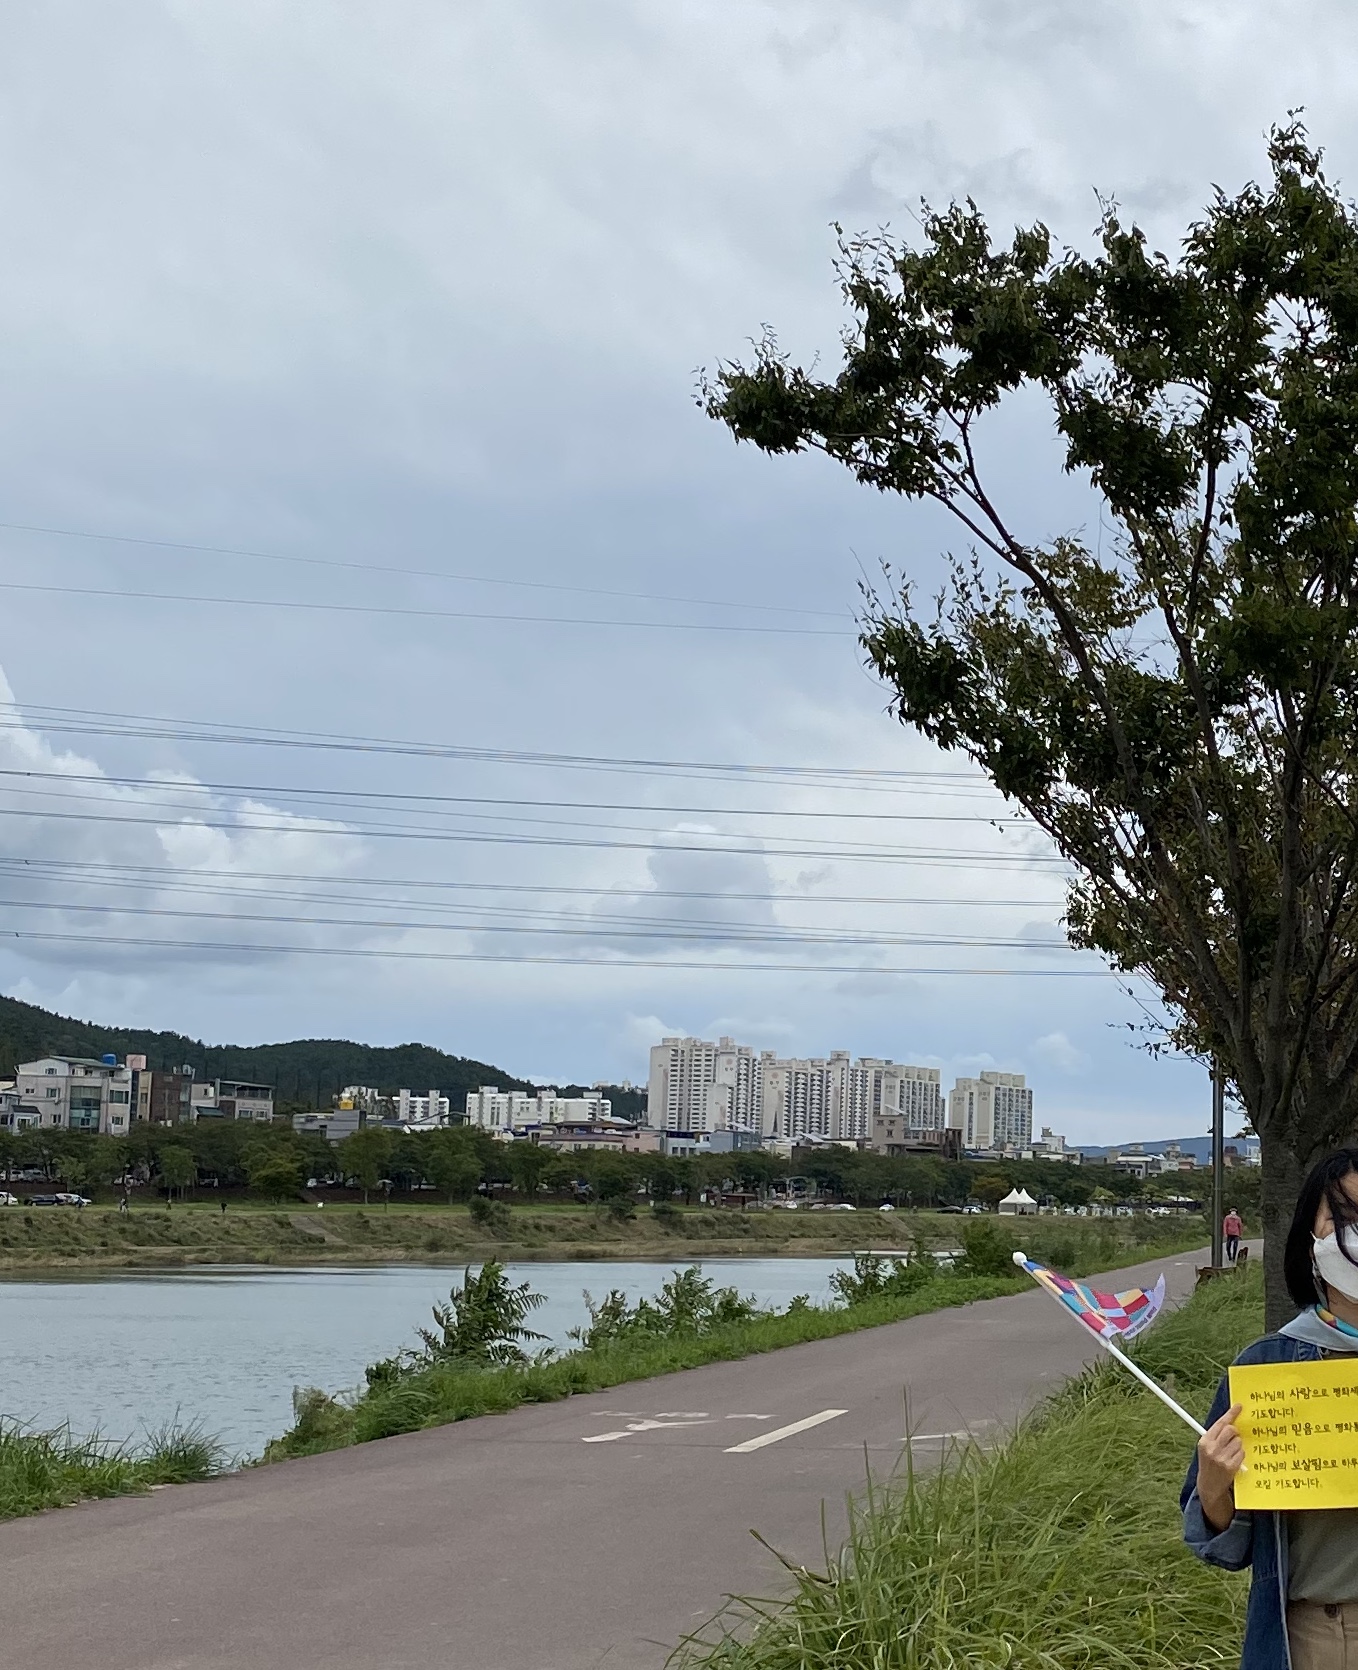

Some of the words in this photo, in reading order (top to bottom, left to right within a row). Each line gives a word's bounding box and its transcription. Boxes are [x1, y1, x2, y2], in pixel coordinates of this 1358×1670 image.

[1250, 1390, 1285, 1403] 하나님의
[1290, 1386, 1329, 1400] 사랑으로
[1252, 1425, 1287, 1437] 하나님의
[1292, 1422, 1331, 1436] 믿음으로
[1253, 1461, 1287, 1473] 하나님의
[1291, 1458, 1338, 1471] 보살핌으로
[1341, 1458, 1358, 1468] 하루
[1255, 1480, 1271, 1489] 오길
